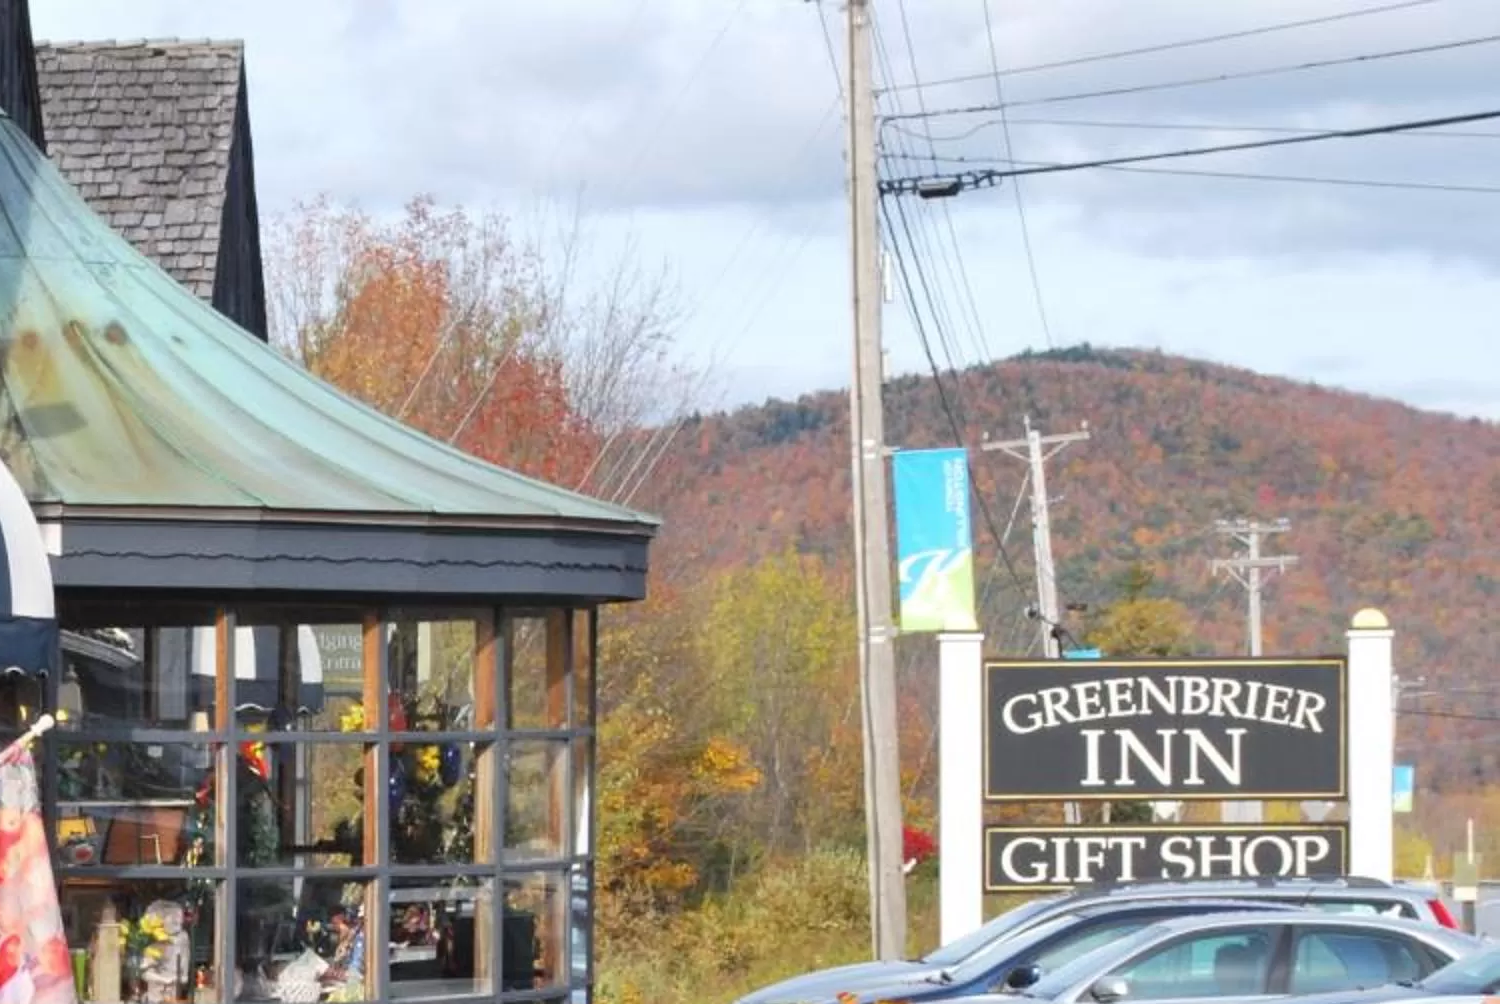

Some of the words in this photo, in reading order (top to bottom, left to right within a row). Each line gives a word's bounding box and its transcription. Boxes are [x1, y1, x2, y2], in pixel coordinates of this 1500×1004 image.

[1002, 675, 1327, 733] GREENBRIER
[1080, 728, 1248, 786] INN
[1000, 836, 1146, 883] GIFT
[1159, 836, 1330, 880] SHOP
